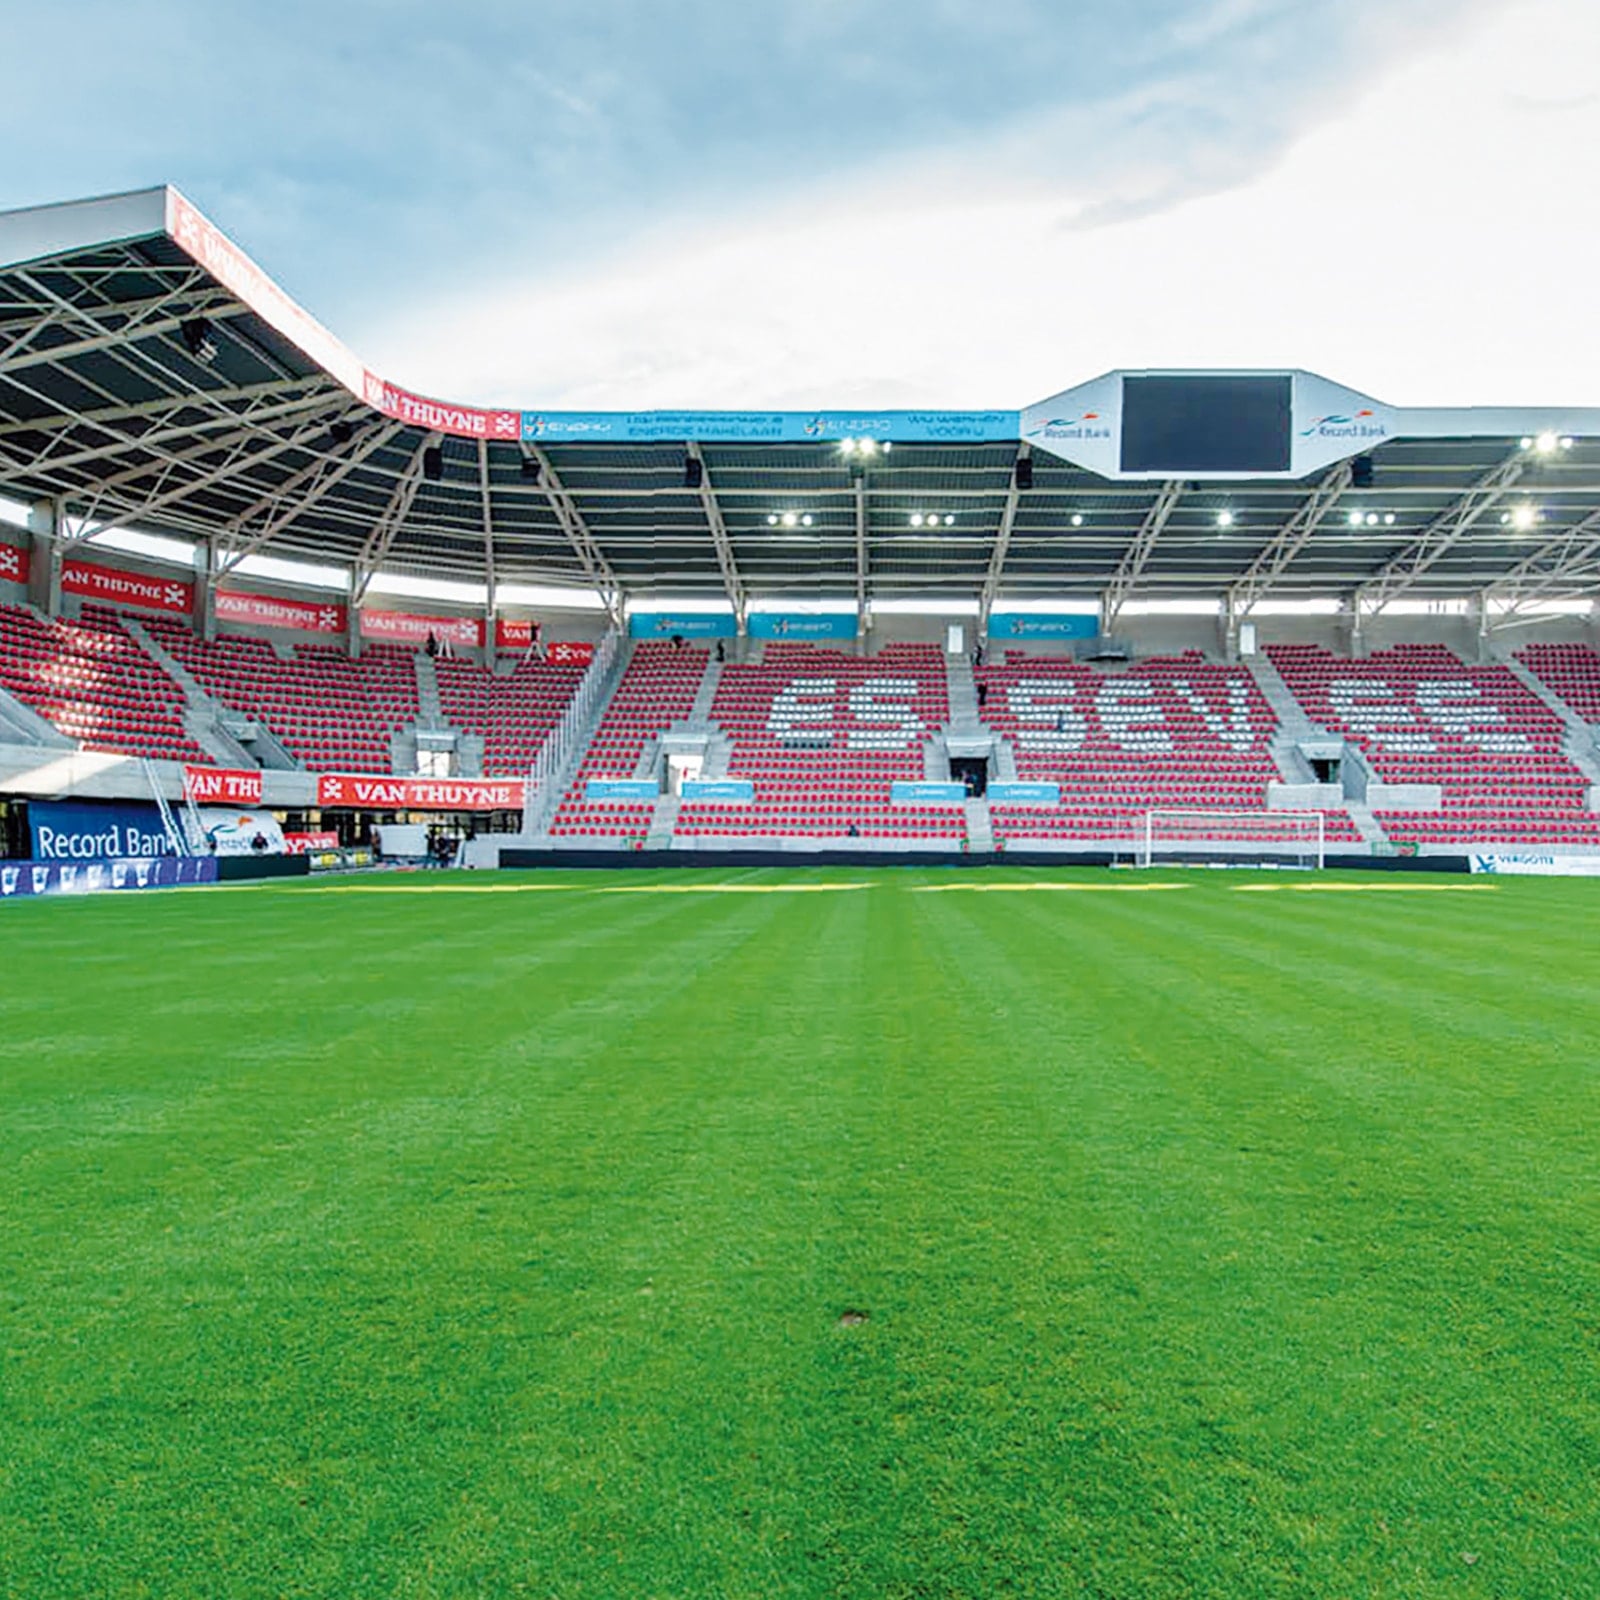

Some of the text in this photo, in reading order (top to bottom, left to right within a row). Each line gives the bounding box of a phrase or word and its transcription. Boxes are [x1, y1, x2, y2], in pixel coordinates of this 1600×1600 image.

[365, 377, 486, 433] VAN THUYNE
[1044, 427, 1082, 438] Record
[1319, 425, 1386, 437] Record Bank
[92, 574, 161, 599] THUYNE
[255, 602, 317, 622] THUYNE
[365, 616, 396, 630] VAN
[184, 773, 262, 798] VAN THU
[354, 782, 509, 804] VAN THUYNE
[39, 824, 122, 859] Record
